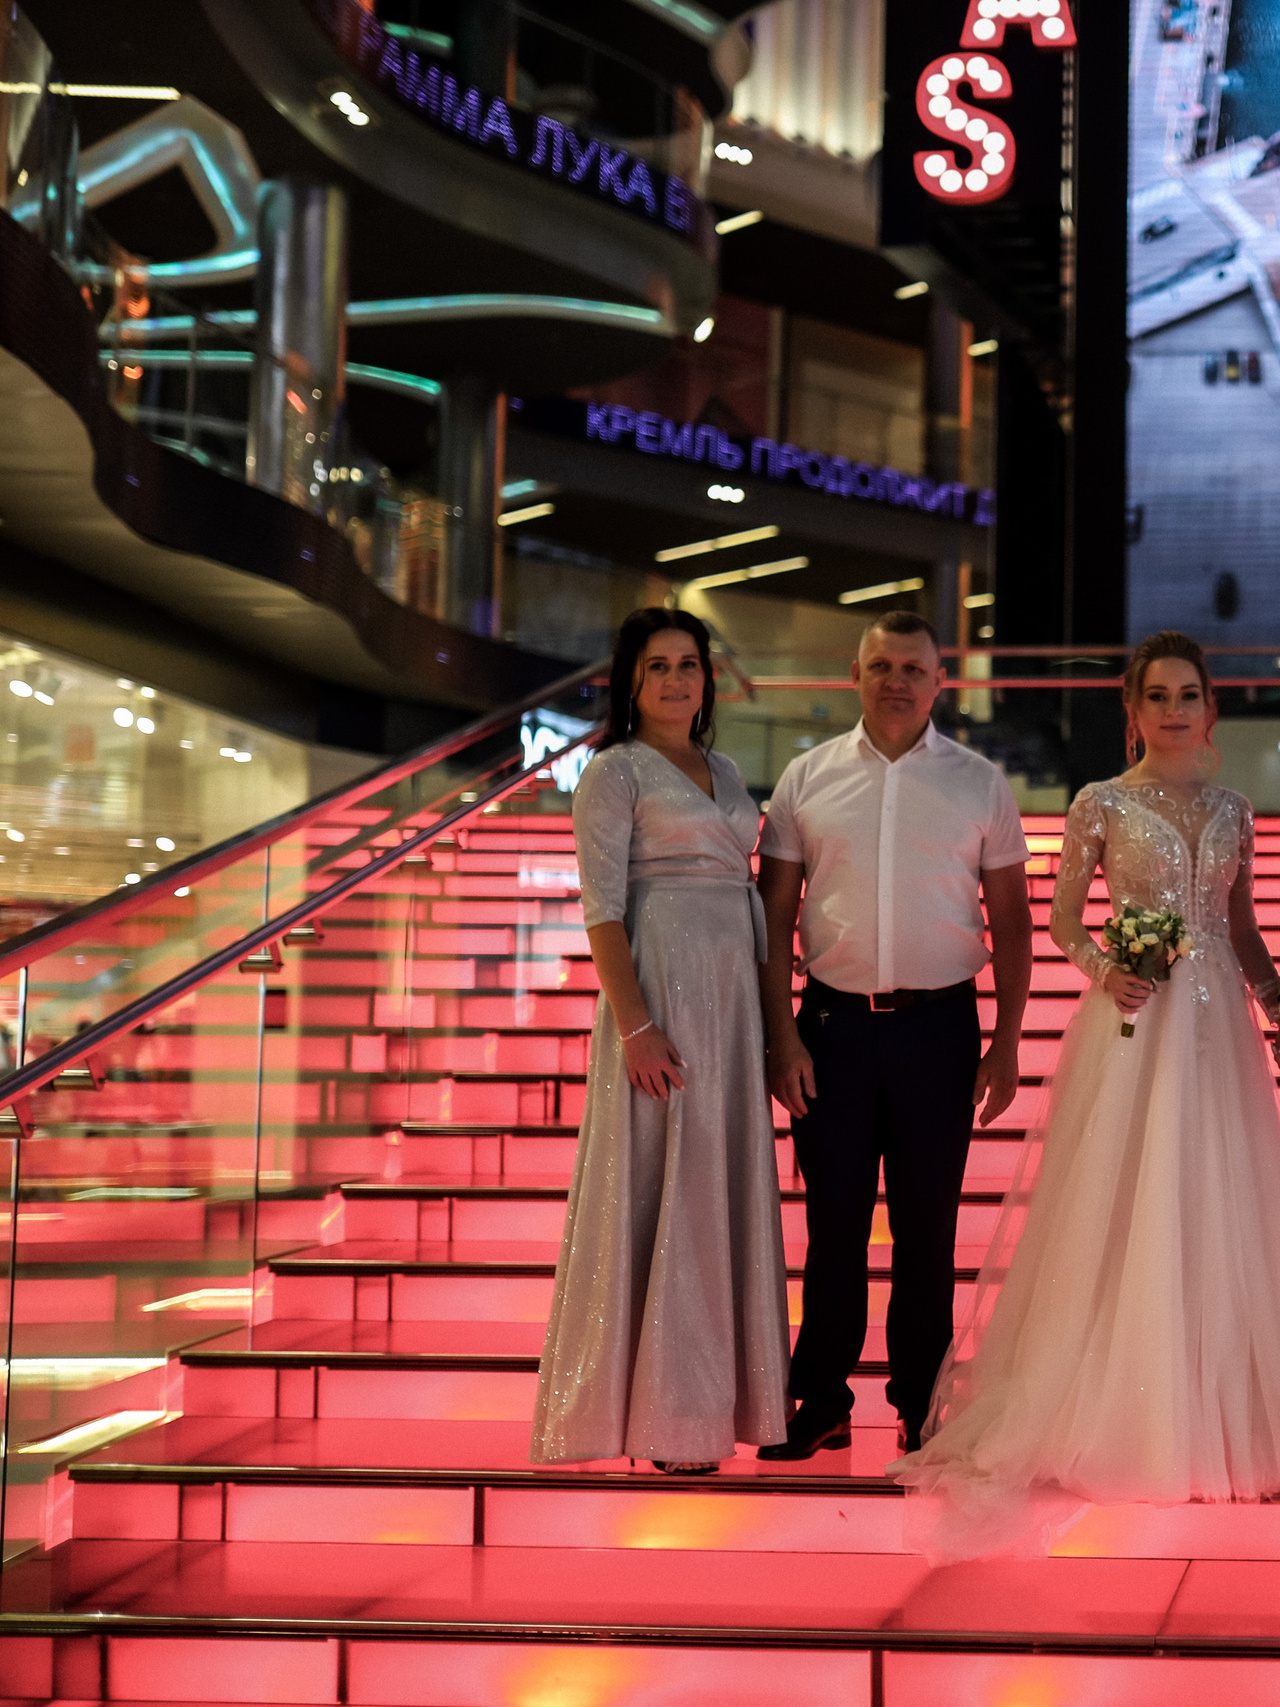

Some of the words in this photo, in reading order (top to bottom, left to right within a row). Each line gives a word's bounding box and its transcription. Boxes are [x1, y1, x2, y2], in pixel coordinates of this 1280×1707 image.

[527, 114, 657, 215] ЛУКА
[586, 401, 745, 471] КРЕМЛЬ
[750, 436, 968, 519] ПРОДОЛЖИТ
